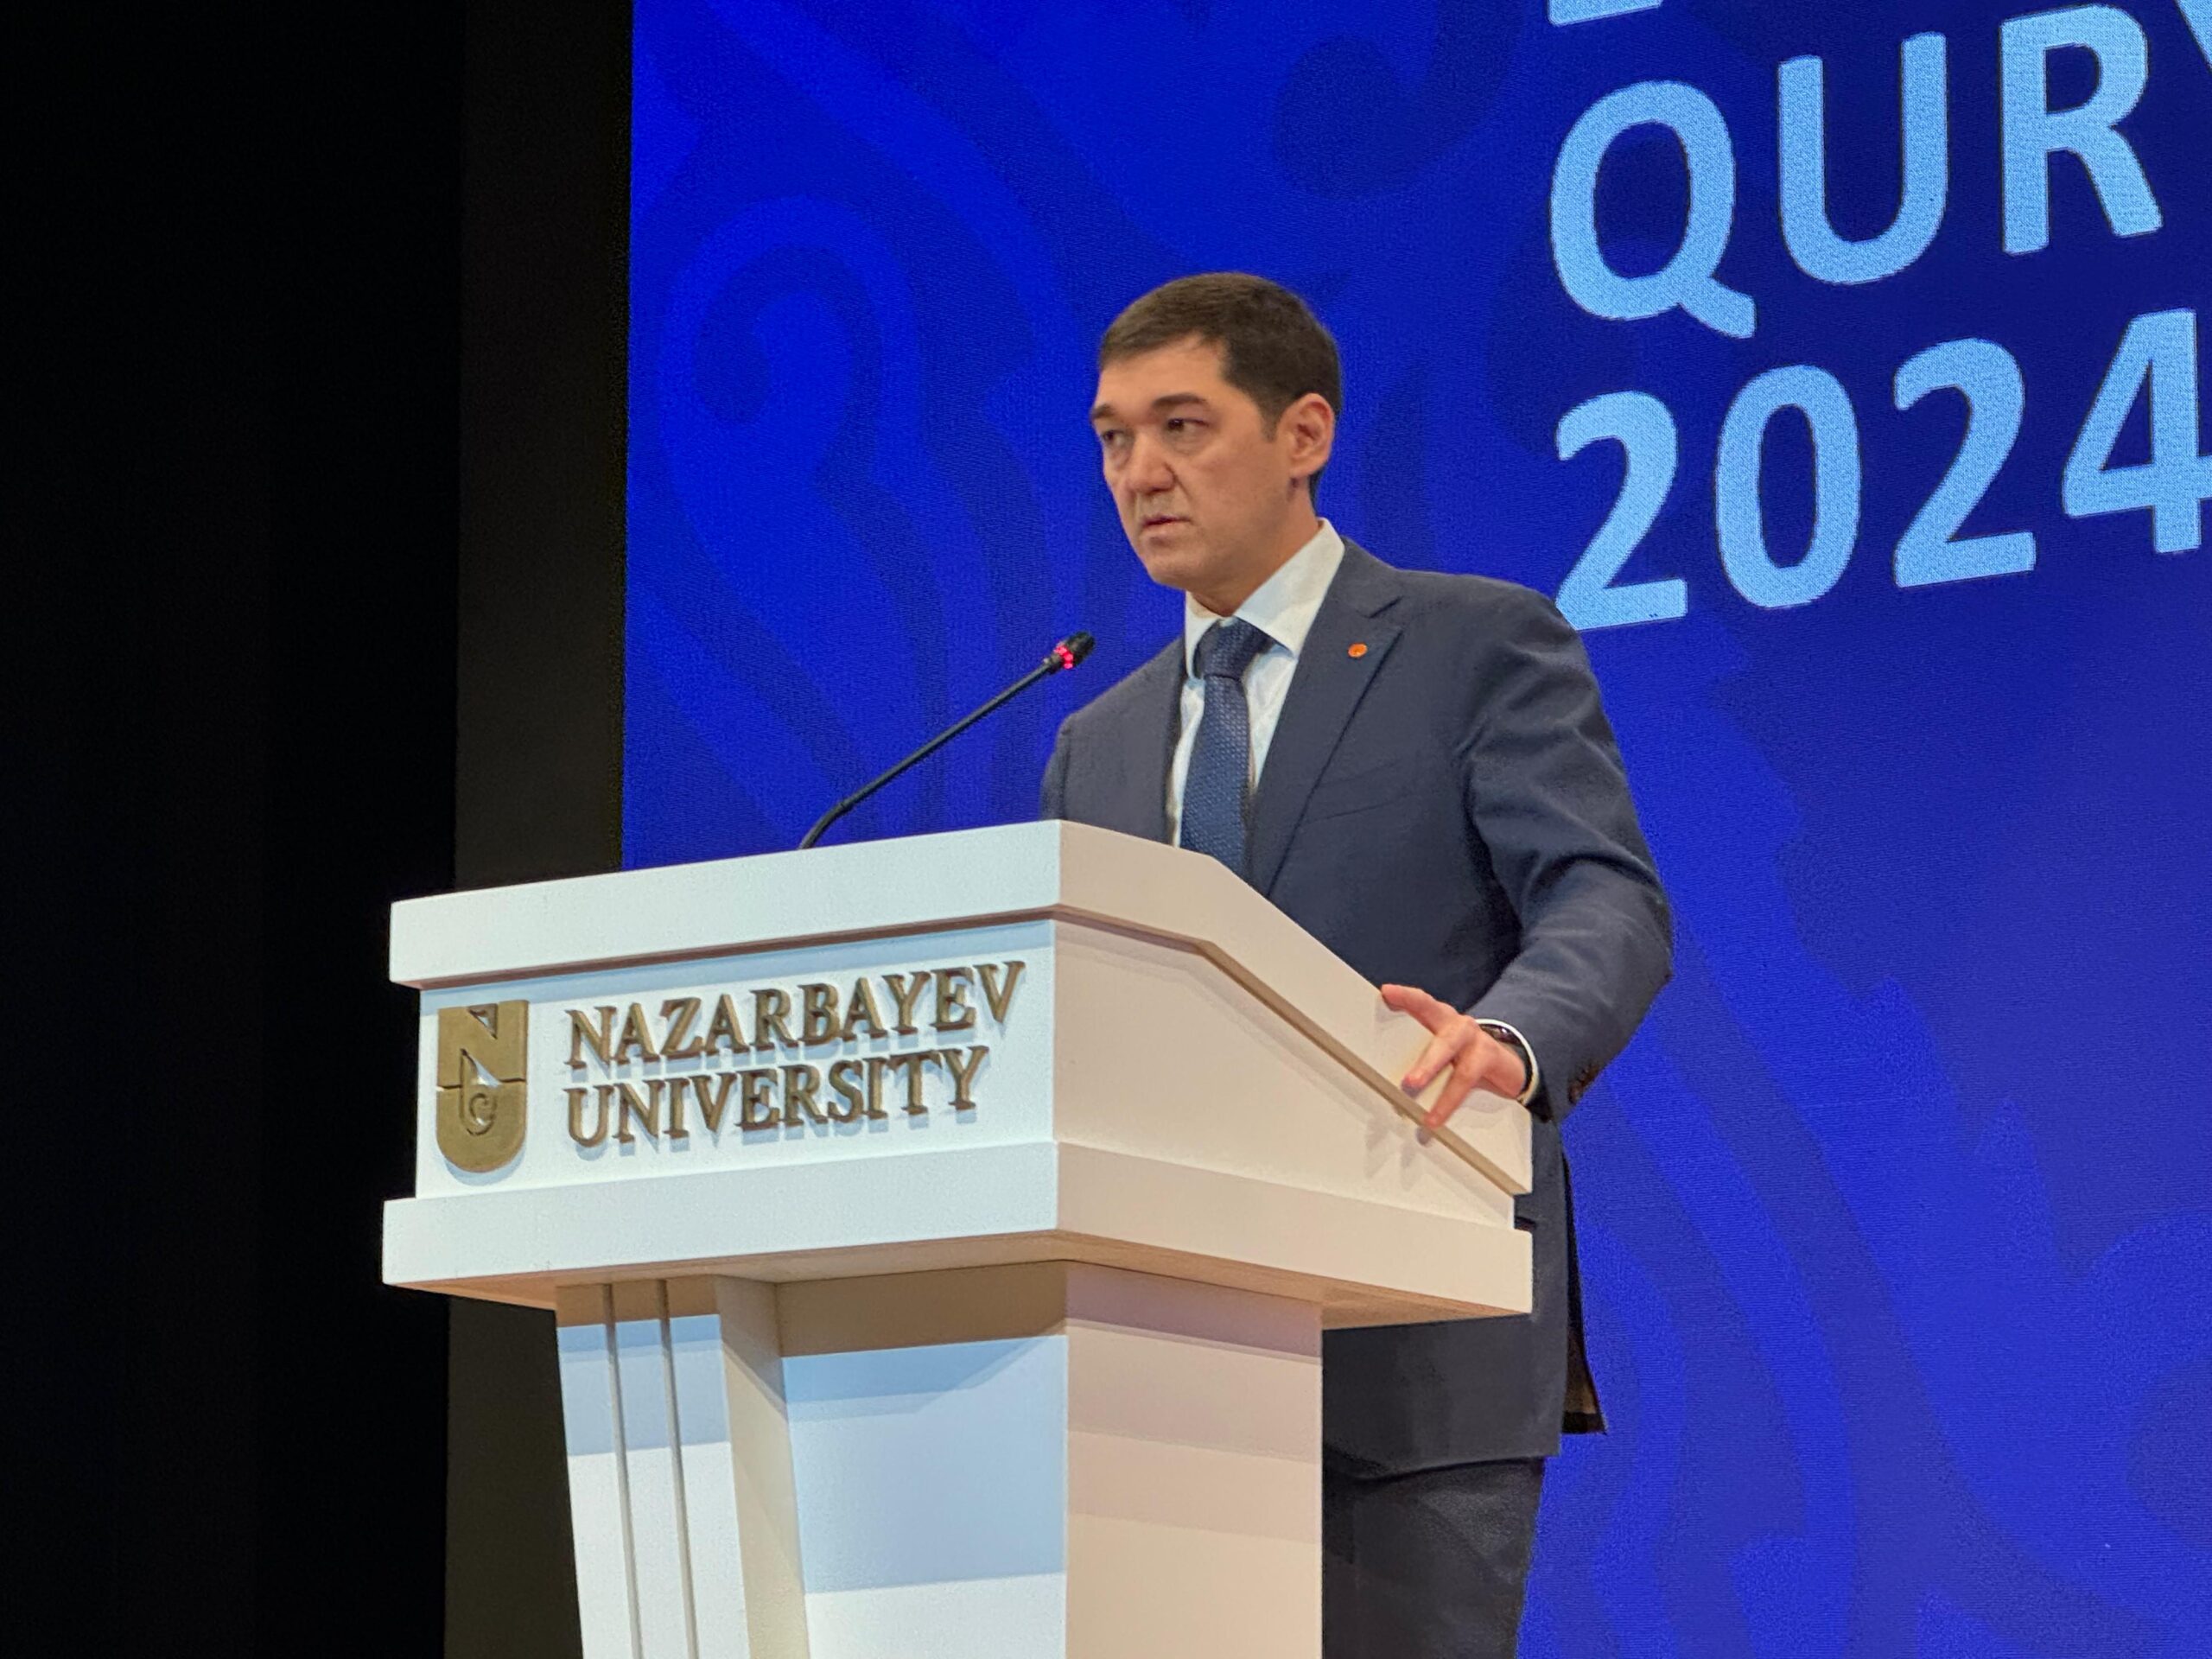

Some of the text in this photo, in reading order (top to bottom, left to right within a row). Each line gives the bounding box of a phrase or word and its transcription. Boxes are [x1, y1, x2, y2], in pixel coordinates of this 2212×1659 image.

[1549, 0, 2212, 338] QUR
[1556, 308, 2212, 631] 2024
[564, 960, 1026, 1070] NAZARBAYEV
[564, 1046, 990, 1147] UNIVERSITY
